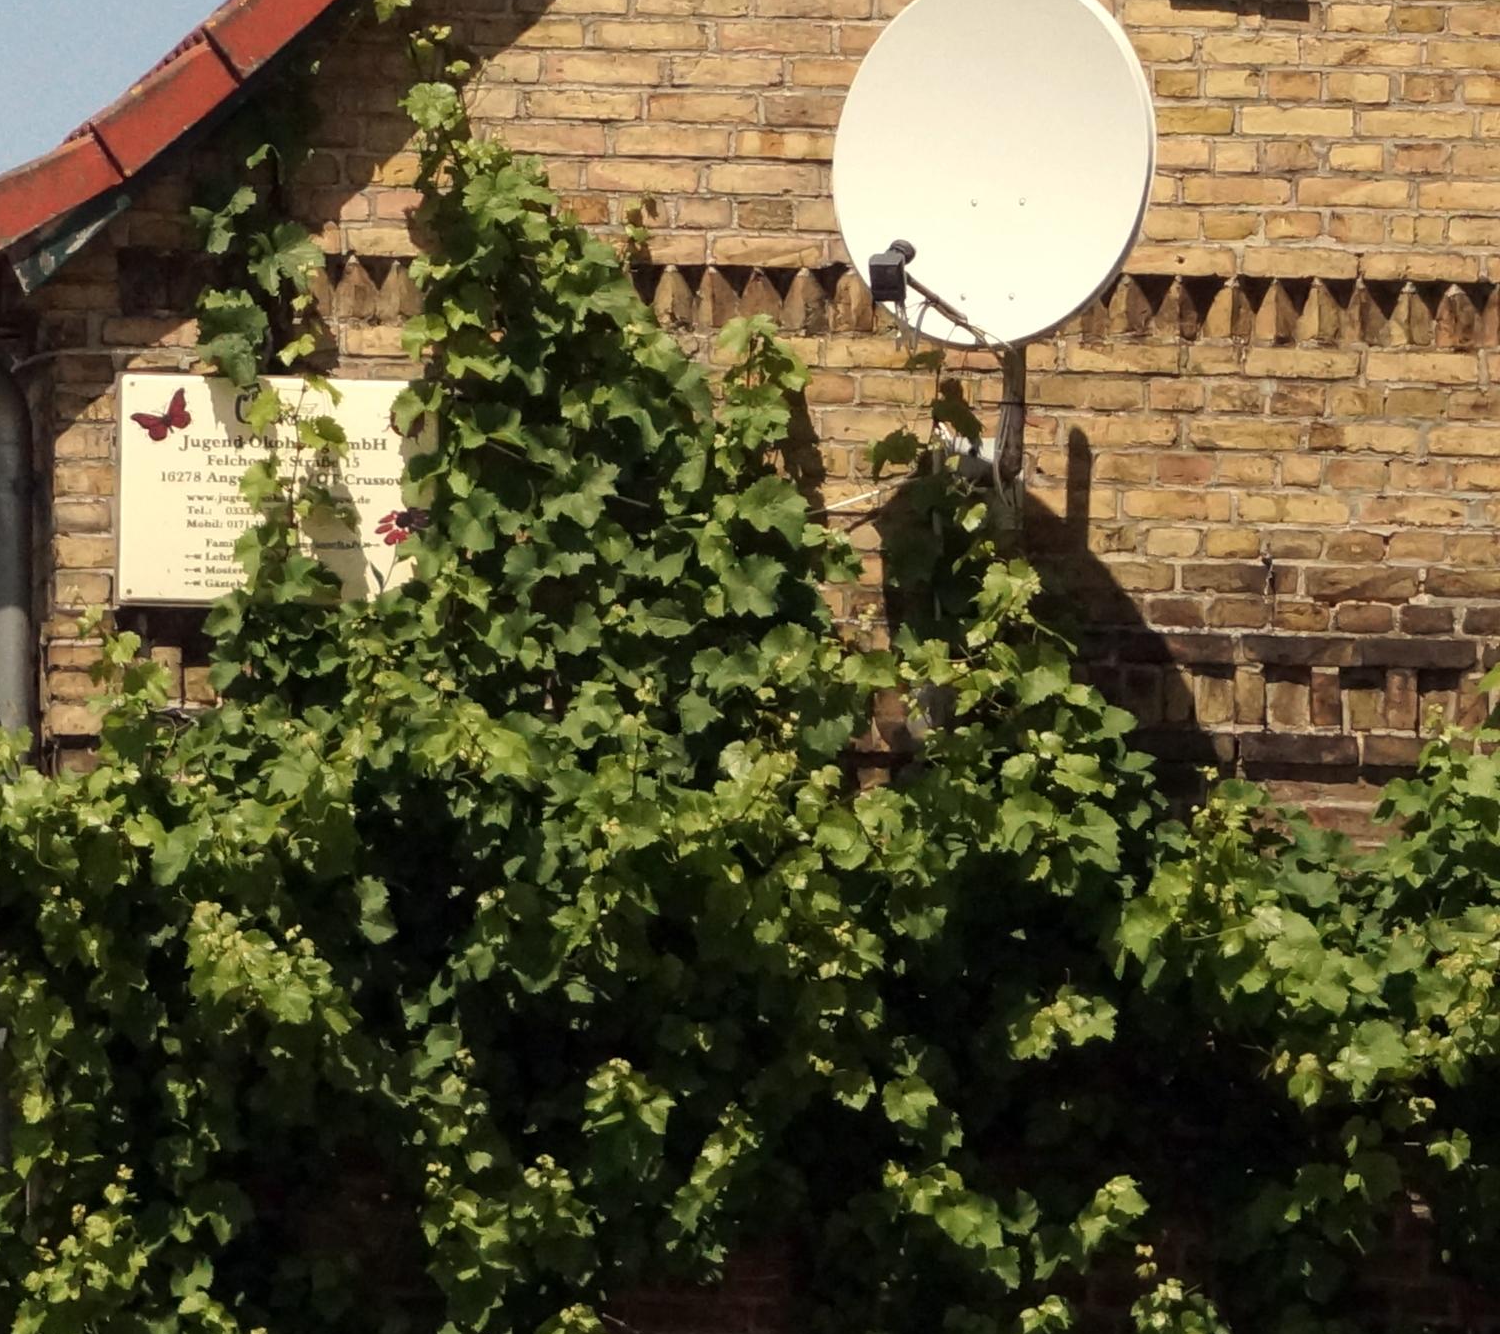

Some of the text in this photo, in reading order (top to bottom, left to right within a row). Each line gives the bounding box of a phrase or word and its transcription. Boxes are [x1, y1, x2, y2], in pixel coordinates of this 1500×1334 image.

[206, 454, 283, 467] Felchor
[345, 457, 361, 468] 15
[160, 470, 202, 482] 16278
